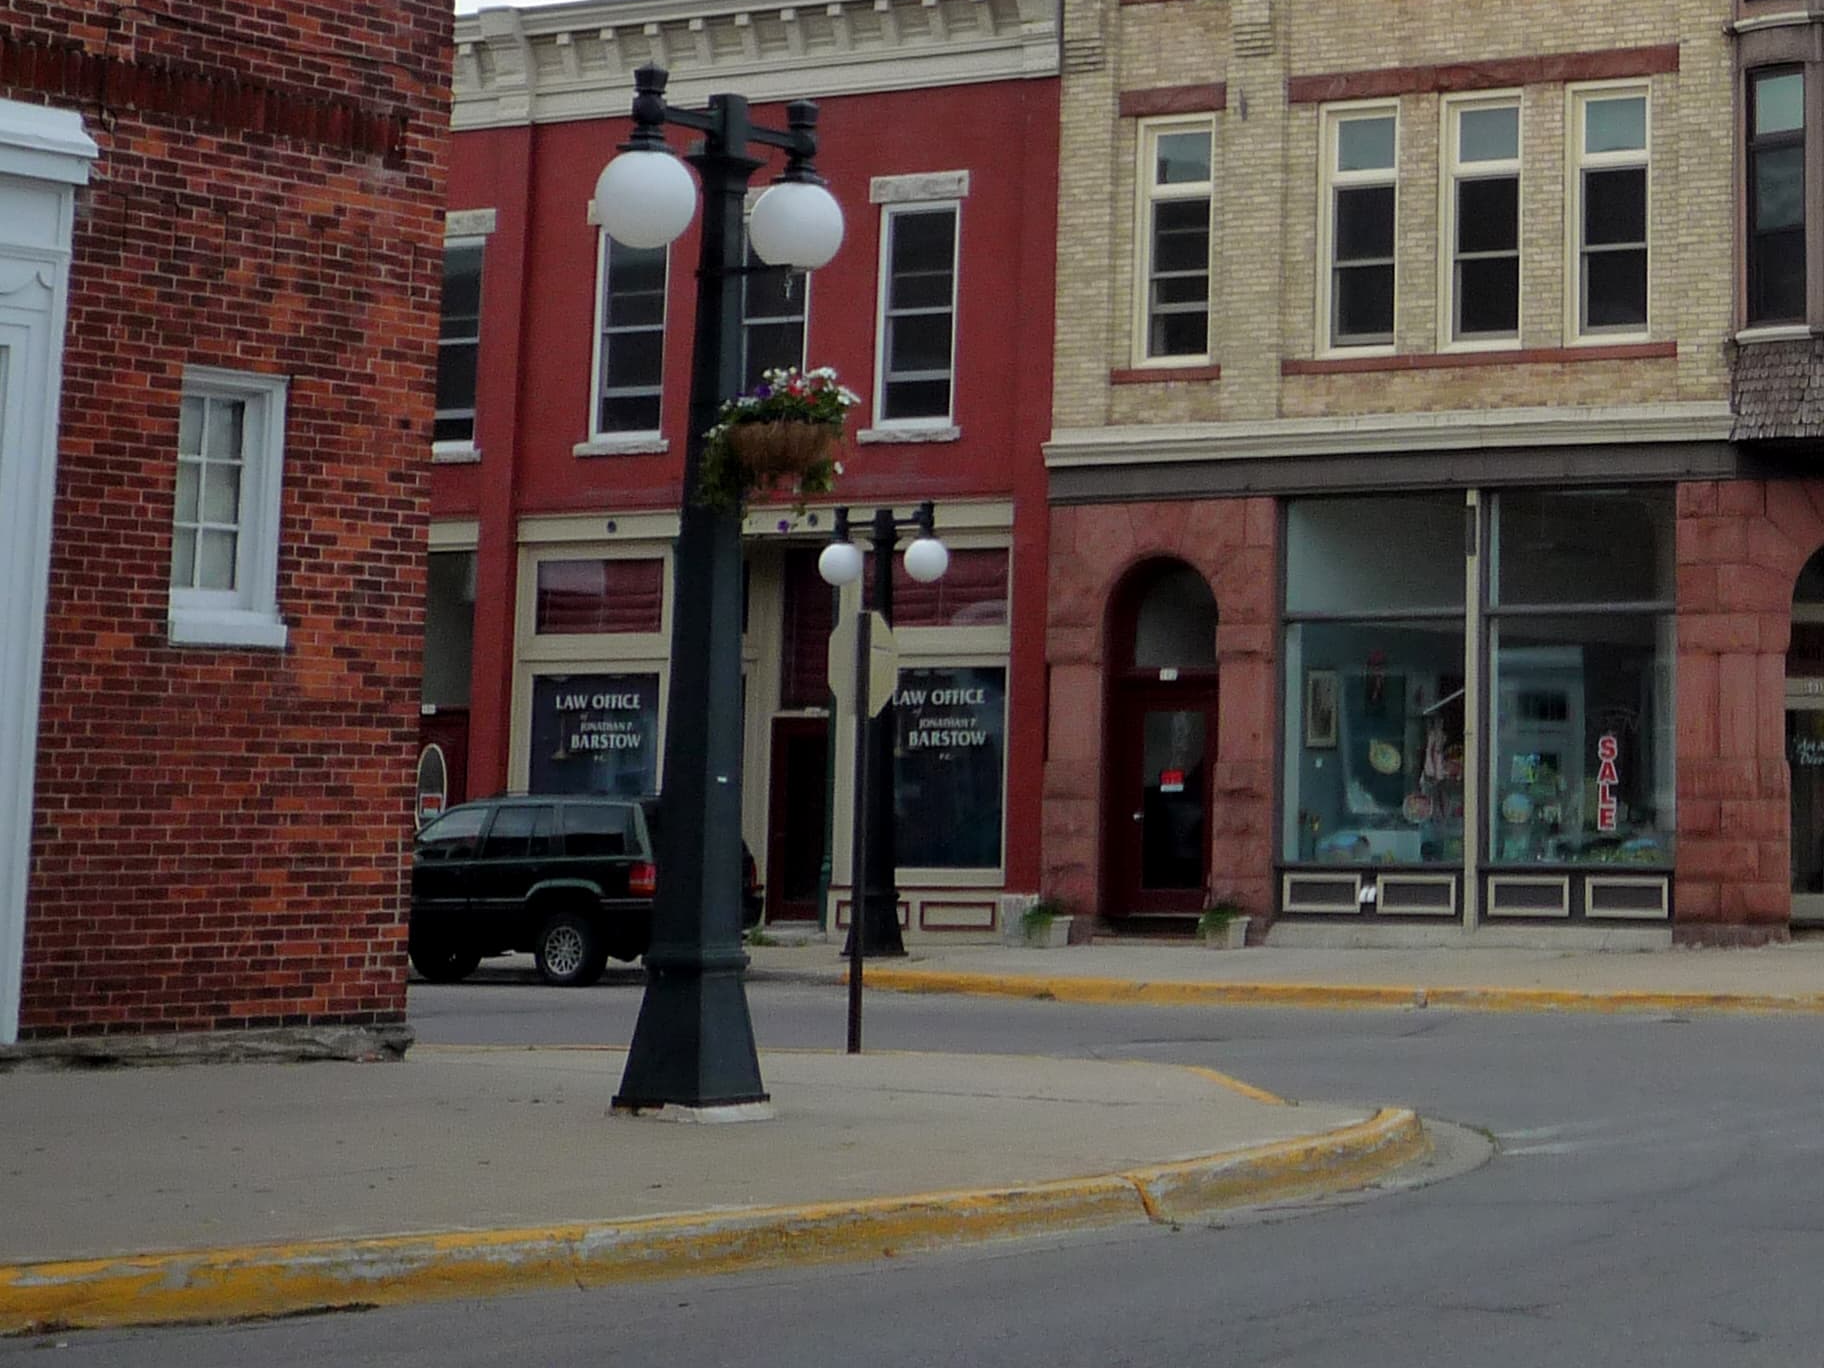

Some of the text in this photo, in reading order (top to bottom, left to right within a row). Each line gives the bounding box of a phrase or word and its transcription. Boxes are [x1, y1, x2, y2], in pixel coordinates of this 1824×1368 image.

[556, 694, 641, 710] LAW OFFICE
[892, 688, 985, 705] LAW OFFICE
[581, 721, 626, 732] JONATHAN
[919, 717, 968, 729] JONATHAN
[571, 734, 641, 749] BARSTOW
[909, 731, 986, 746] BARSTOW
[1598, 735, 1618, 832] SALE
